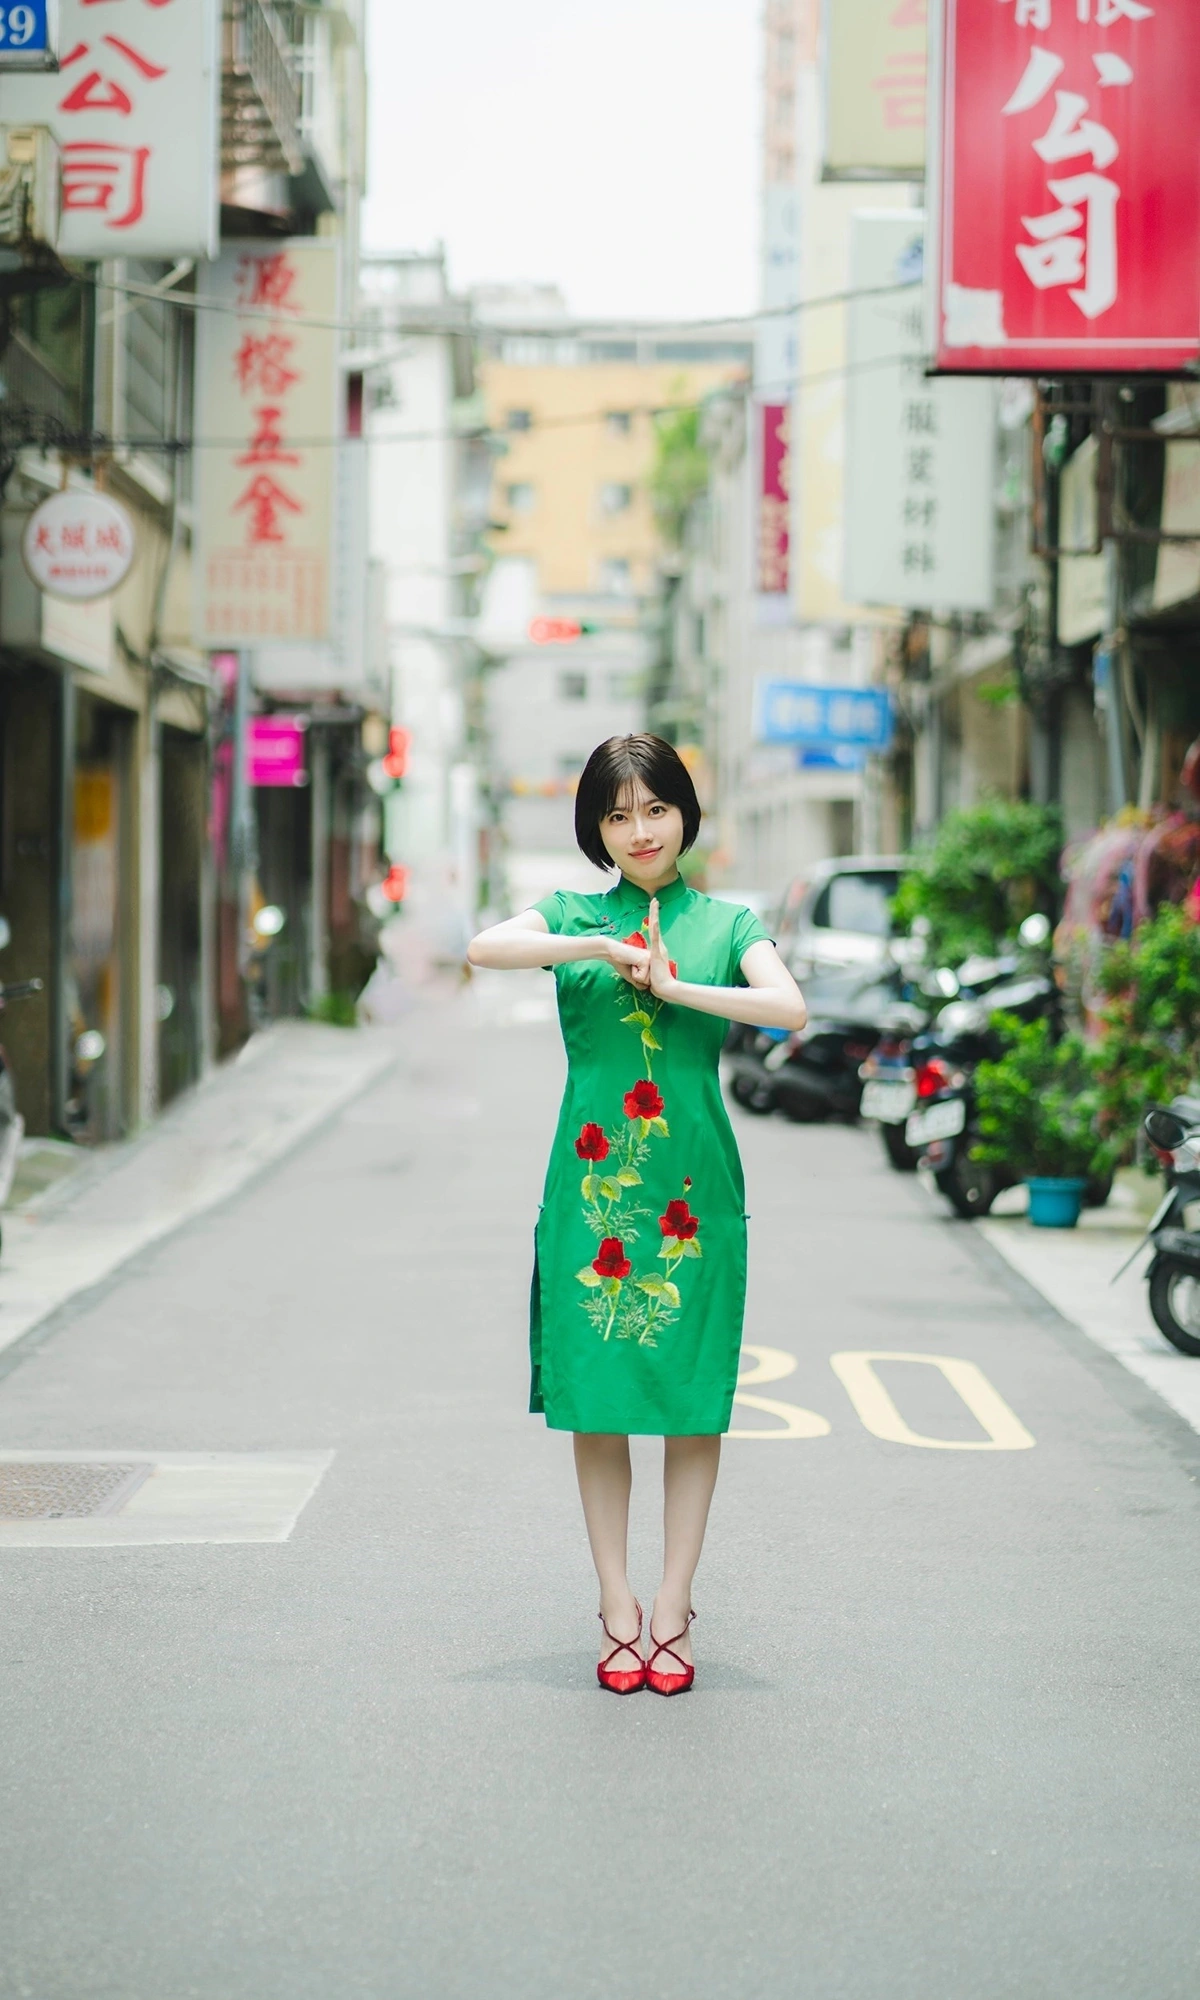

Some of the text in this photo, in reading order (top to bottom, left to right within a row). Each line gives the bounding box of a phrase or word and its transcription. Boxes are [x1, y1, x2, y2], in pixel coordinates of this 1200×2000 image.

[0, 5, 36, 45] 9
[60, 0, 174, 228] 公司
[1000, 45, 1134, 319] 公司
